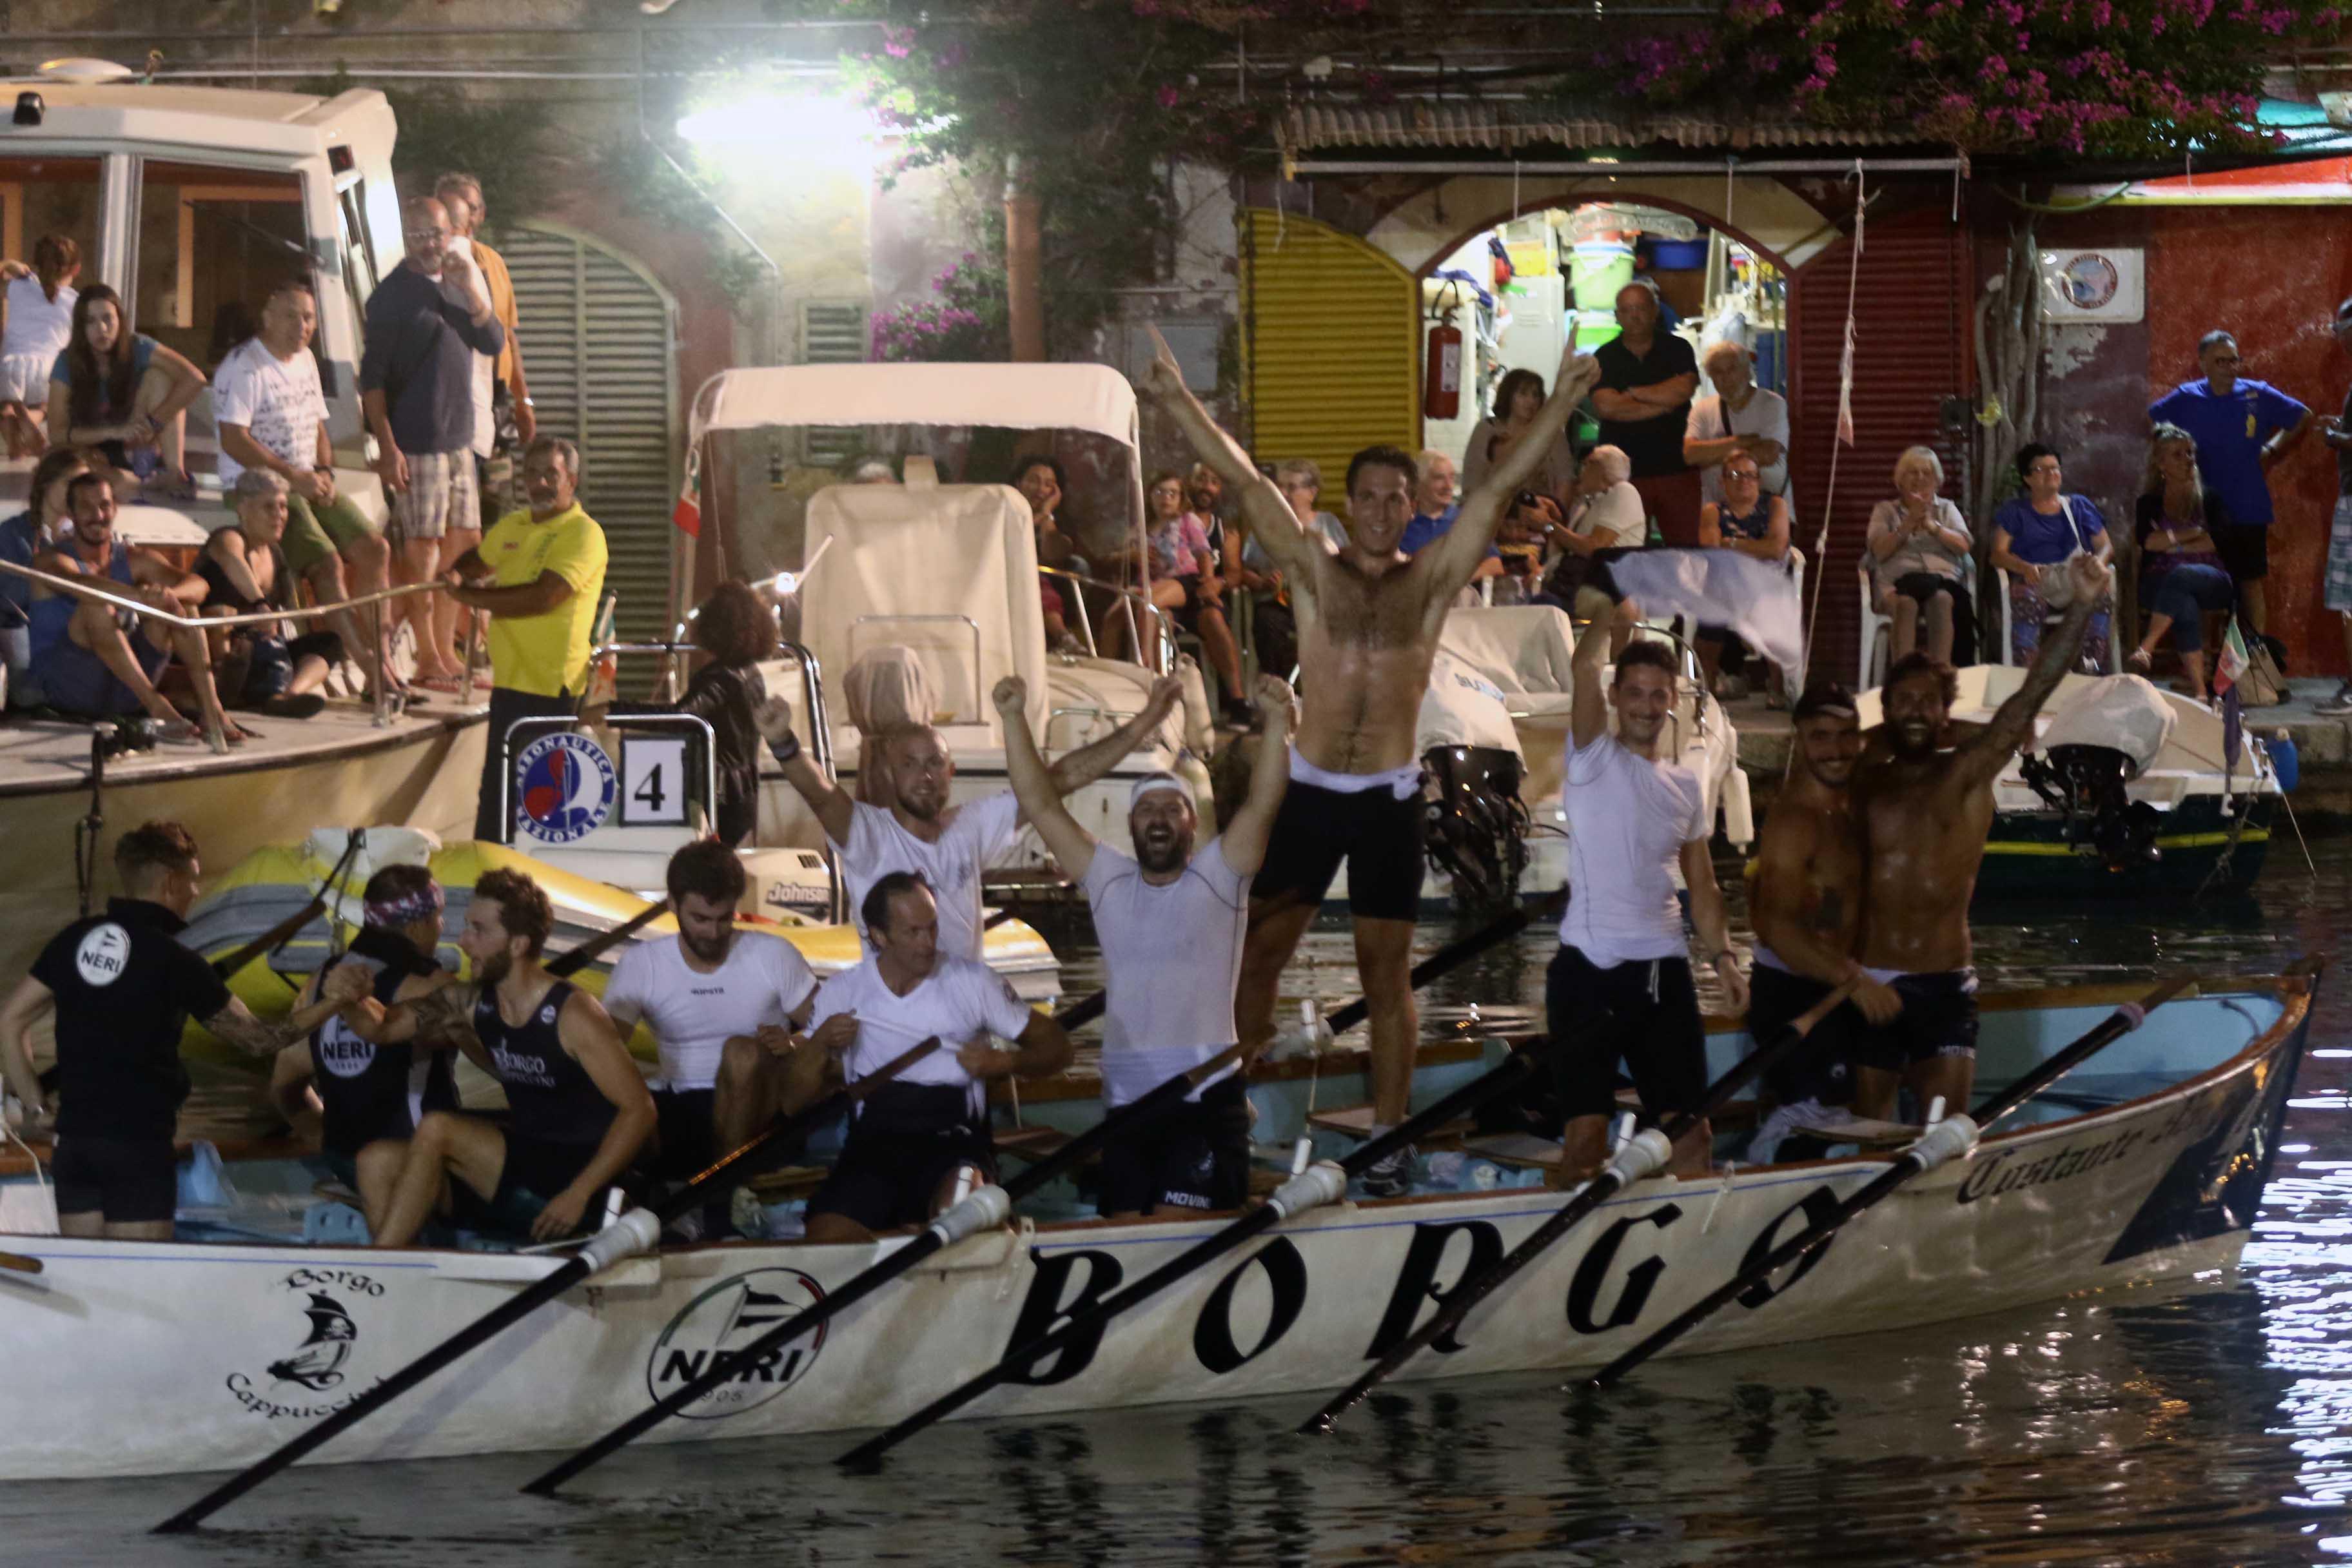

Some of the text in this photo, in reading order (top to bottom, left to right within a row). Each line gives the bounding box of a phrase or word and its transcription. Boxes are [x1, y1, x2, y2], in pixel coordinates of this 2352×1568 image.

[634, 762, 665, 812] 4
[81, 950, 121, 973] NERI
[323, 1043, 373, 1059] NERI
[284, 1268, 385, 1297] Borgo
[997, 1184, 1843, 1385] BORGO
